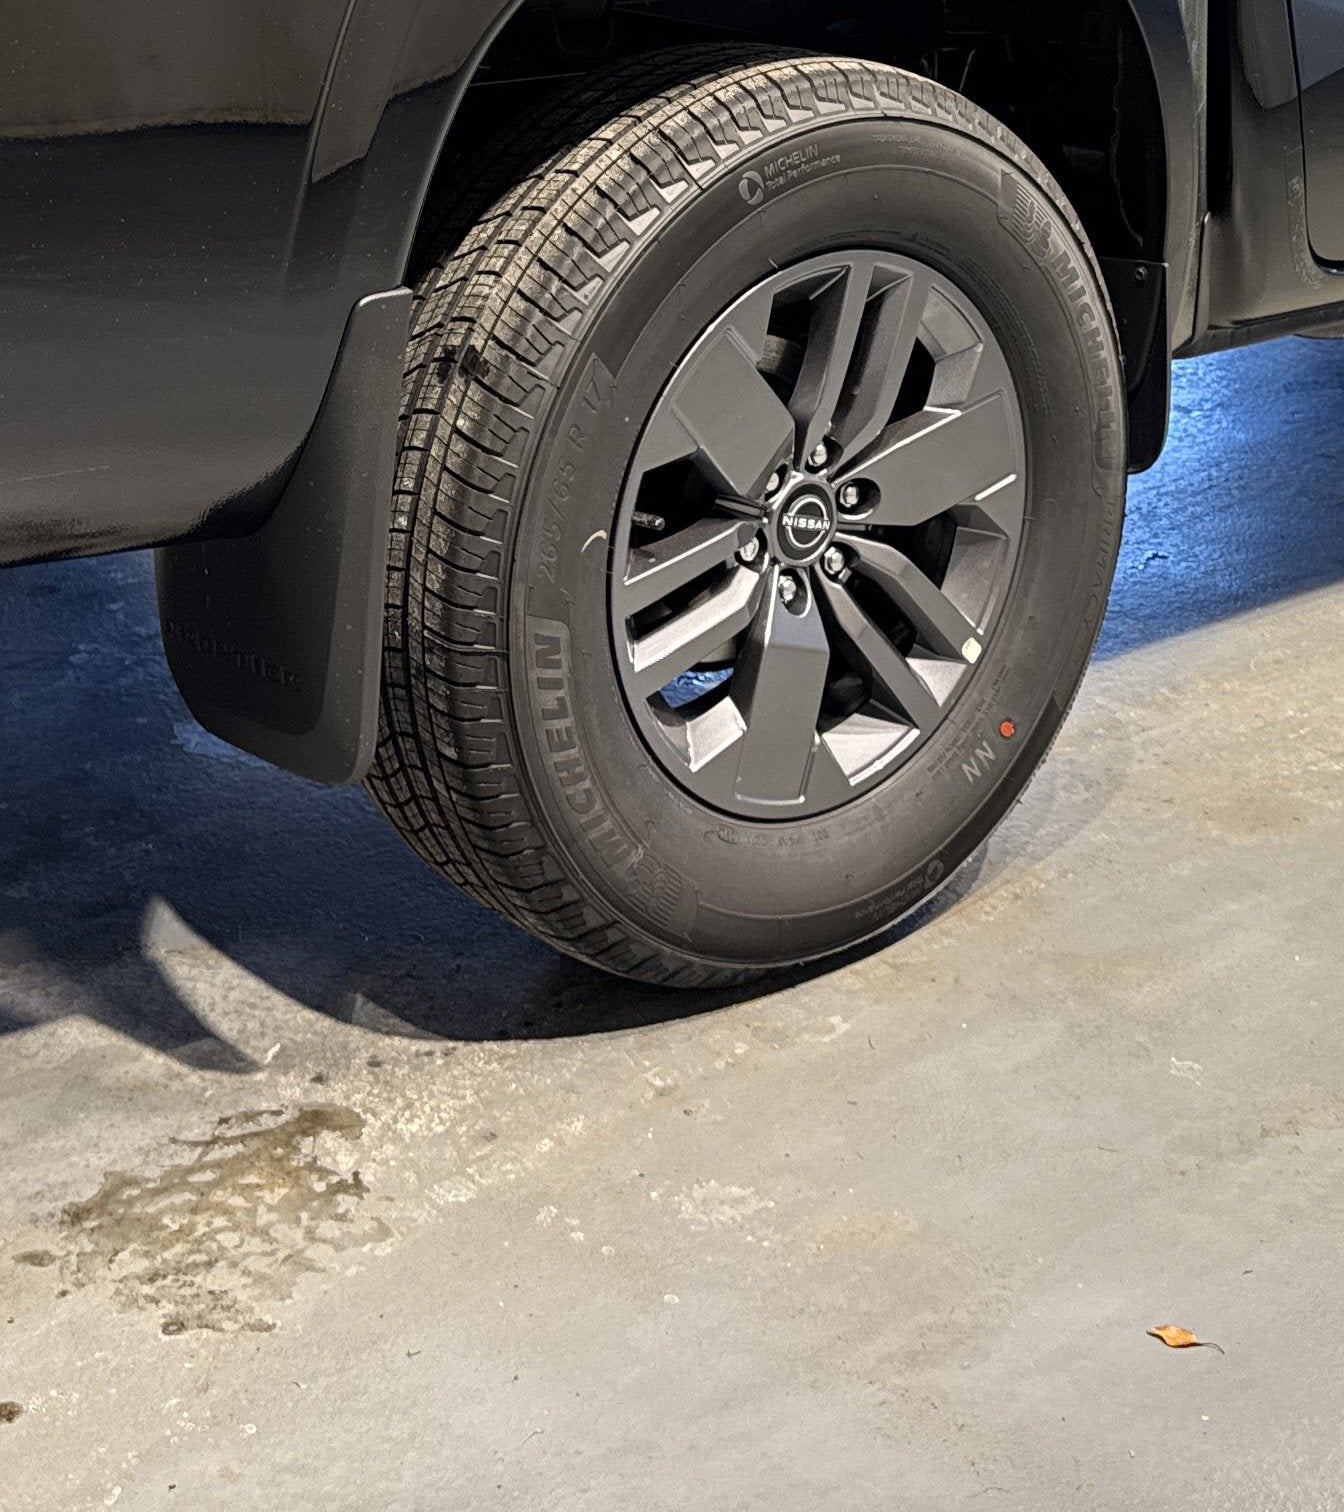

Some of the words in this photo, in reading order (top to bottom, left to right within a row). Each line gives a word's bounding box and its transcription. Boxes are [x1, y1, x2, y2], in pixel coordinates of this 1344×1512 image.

[763, 144, 819, 178] MICHELIN
[786, 154, 841, 180] Performance
[1052, 249, 1118, 463] MICHELIN
[782, 514, 831, 530] NISSAN
[534, 632, 631, 869] MICHELIN
